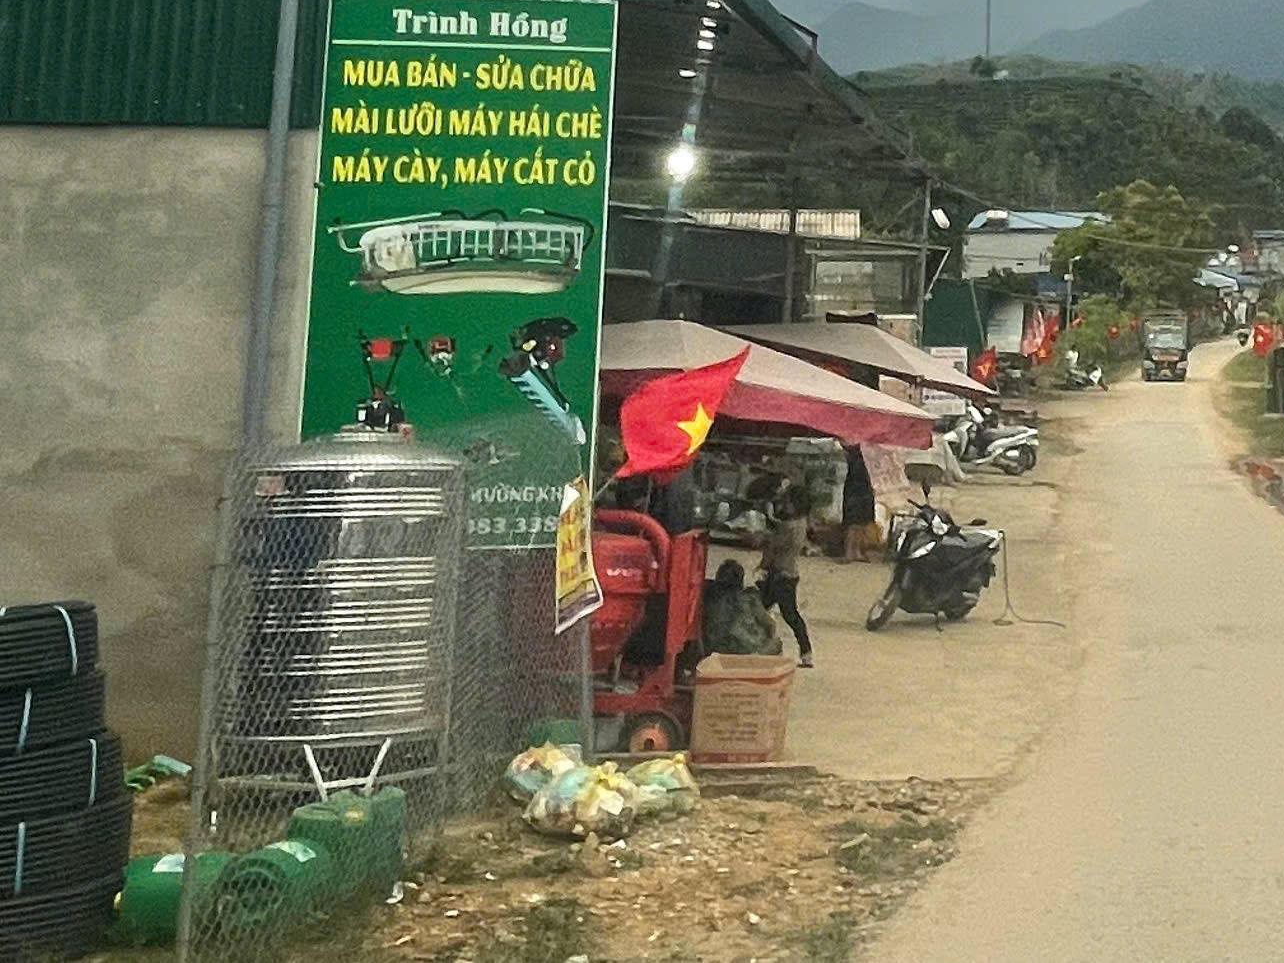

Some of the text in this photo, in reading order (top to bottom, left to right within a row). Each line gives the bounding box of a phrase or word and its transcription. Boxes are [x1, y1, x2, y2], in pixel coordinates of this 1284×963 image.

[392, 8, 478, 36] Trình
[343, 59, 400, 87] MUA
[406, 53, 457, 88] BÁN
[475, 54, 525, 90] SỬA
[530, 59, 597, 92] CHỮA
[331, 99, 379, 135] MÀI
[448, 102, 503, 137] MÁY
[508, 103, 550, 138] HÁI
[555, 105, 603, 139] CHÈ
[332, 147, 389, 183] MÁY
[393, 148, 448, 190] CÀY,
[453, 148, 510, 184] MÁY
[563, 150, 596, 186] CỎ
